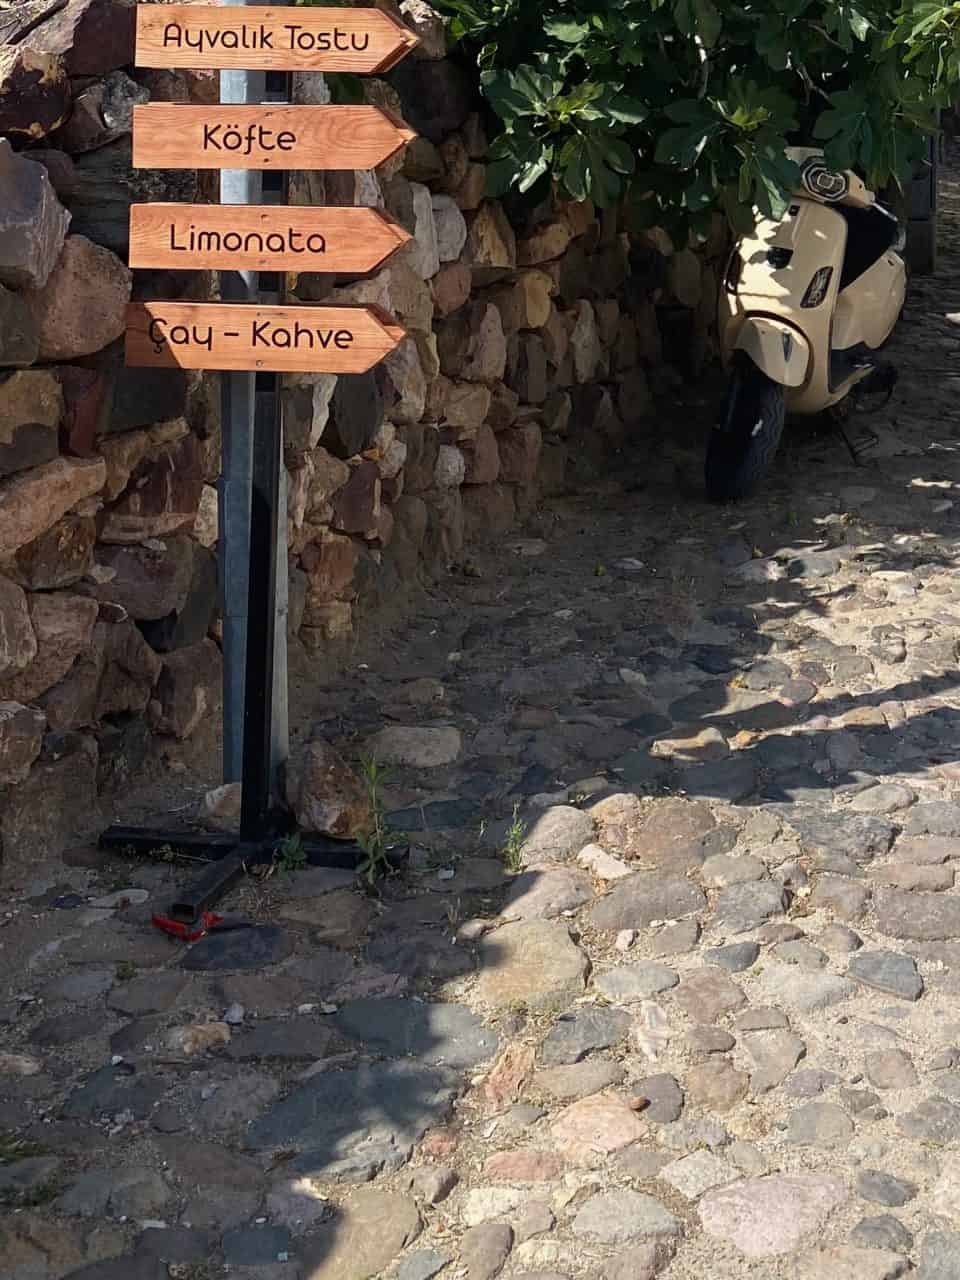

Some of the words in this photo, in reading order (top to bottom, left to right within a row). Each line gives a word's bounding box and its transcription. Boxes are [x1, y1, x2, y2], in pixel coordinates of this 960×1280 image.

[163, 23, 273, 51] Ayvalık
[284, 25, 369, 51] Tostu
[203, 123, 297, 155] Köfte
[170, 225, 326, 253] Limonata
[148, 318, 213, 355] Çay
[251, 320, 354, 349] Kahve
